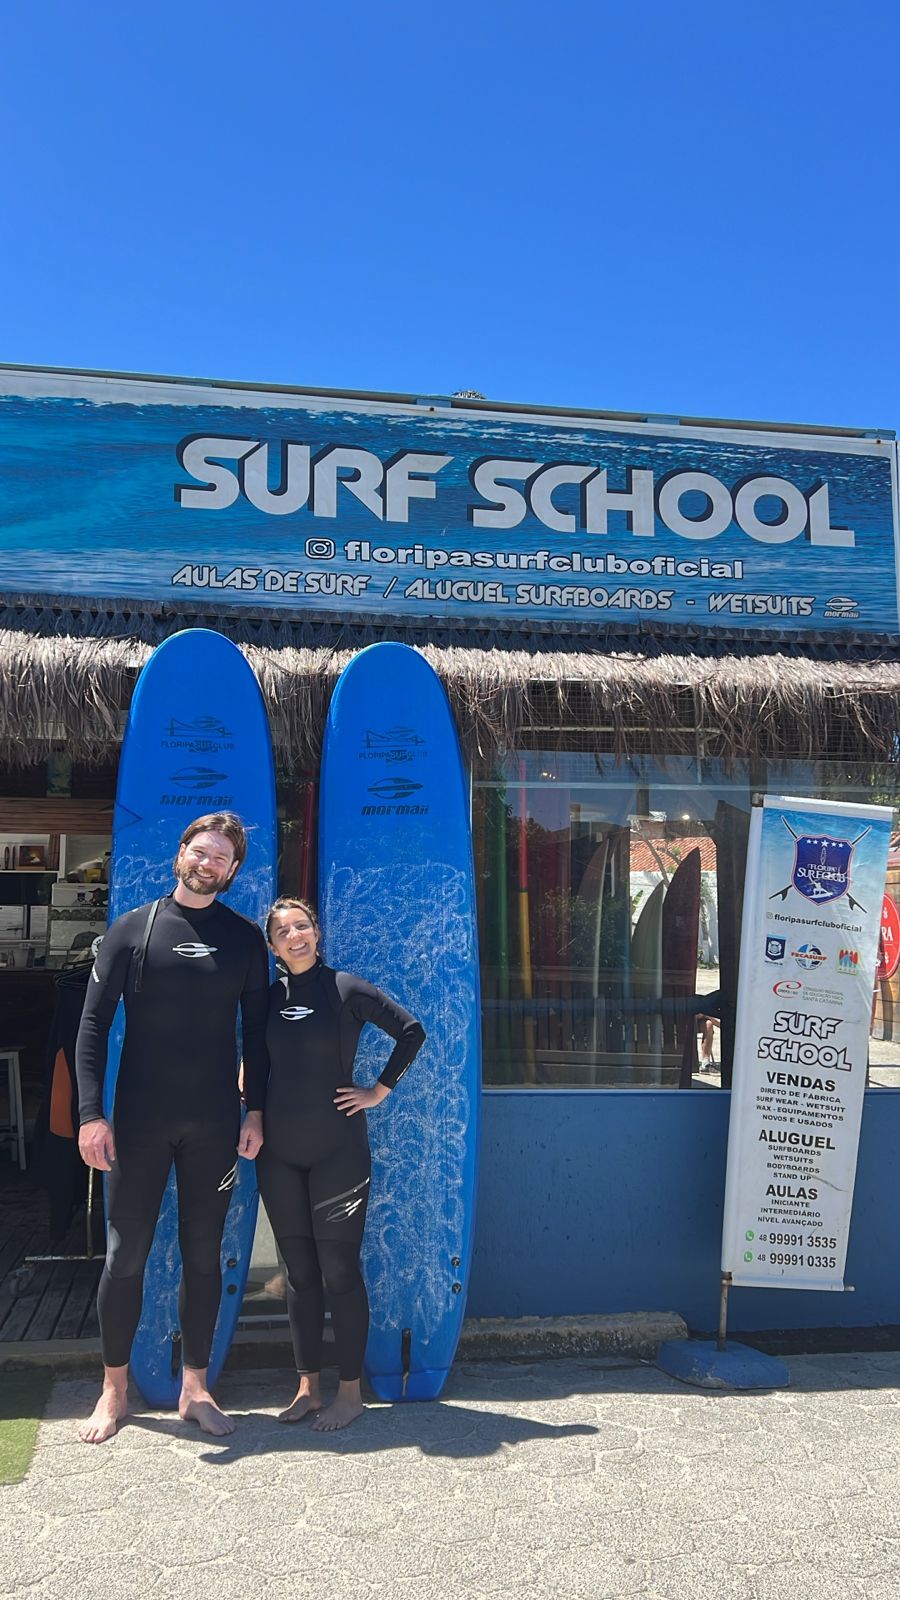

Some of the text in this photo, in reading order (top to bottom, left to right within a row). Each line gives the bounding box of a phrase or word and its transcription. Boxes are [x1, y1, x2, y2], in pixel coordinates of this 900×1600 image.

[175, 433, 855, 547] SURF SCHOOL
[344, 540, 744, 579] floripasurfcluboficial
[172, 564, 262, 589] AULAS
[263, 569, 303, 593] DE
[304, 571, 371, 596] SURF
[382, 576, 399, 599] /
[404, 577, 510, 604] ALUGUEL
[515, 584, 675, 610] SURFBOARDS
[707, 592, 814, 616] WETSUITS
[361, 804, 430, 816] mormaii
[774, 914, 862, 932] floripasurfcluboficial
[774, 1010, 844, 1040] SURF
[758, 1036, 852, 1072] SCHOOL
[766, 1072, 836, 1092] VENDAS
[760, 1087, 786, 1096] DIRETO
[756, 1104, 772, 1112] WAX
[777, 1106, 844, 1122] EQUIPAMENTOS
[776, 1098, 798, 1106] WEAR
[806, 1102, 846, 1112] WETSUIT
[762, 1114, 787, 1122] NOVOS
[798, 1118, 833, 1128] USADOS
[758, 1130, 836, 1150] ALUGUEL
[768, 1145, 822, 1156] SURFBOARDS
[774, 1154, 814, 1164] WETSUITS
[766, 1162, 820, 1174] BODYBOARDS
[773, 1172, 798, 1180] STAND
[766, 1184, 818, 1200] AULAS
[771, 1199, 811, 1208] INICIANTE
[760, 1208, 821, 1218] INTERMEDIÁRIO
[758, 1216, 823, 1227] NÍVEL AVANÇADO
[758, 1232, 837, 1248] 48 99991 3535
[758, 1252, 836, 1268] 48 99991 0335
